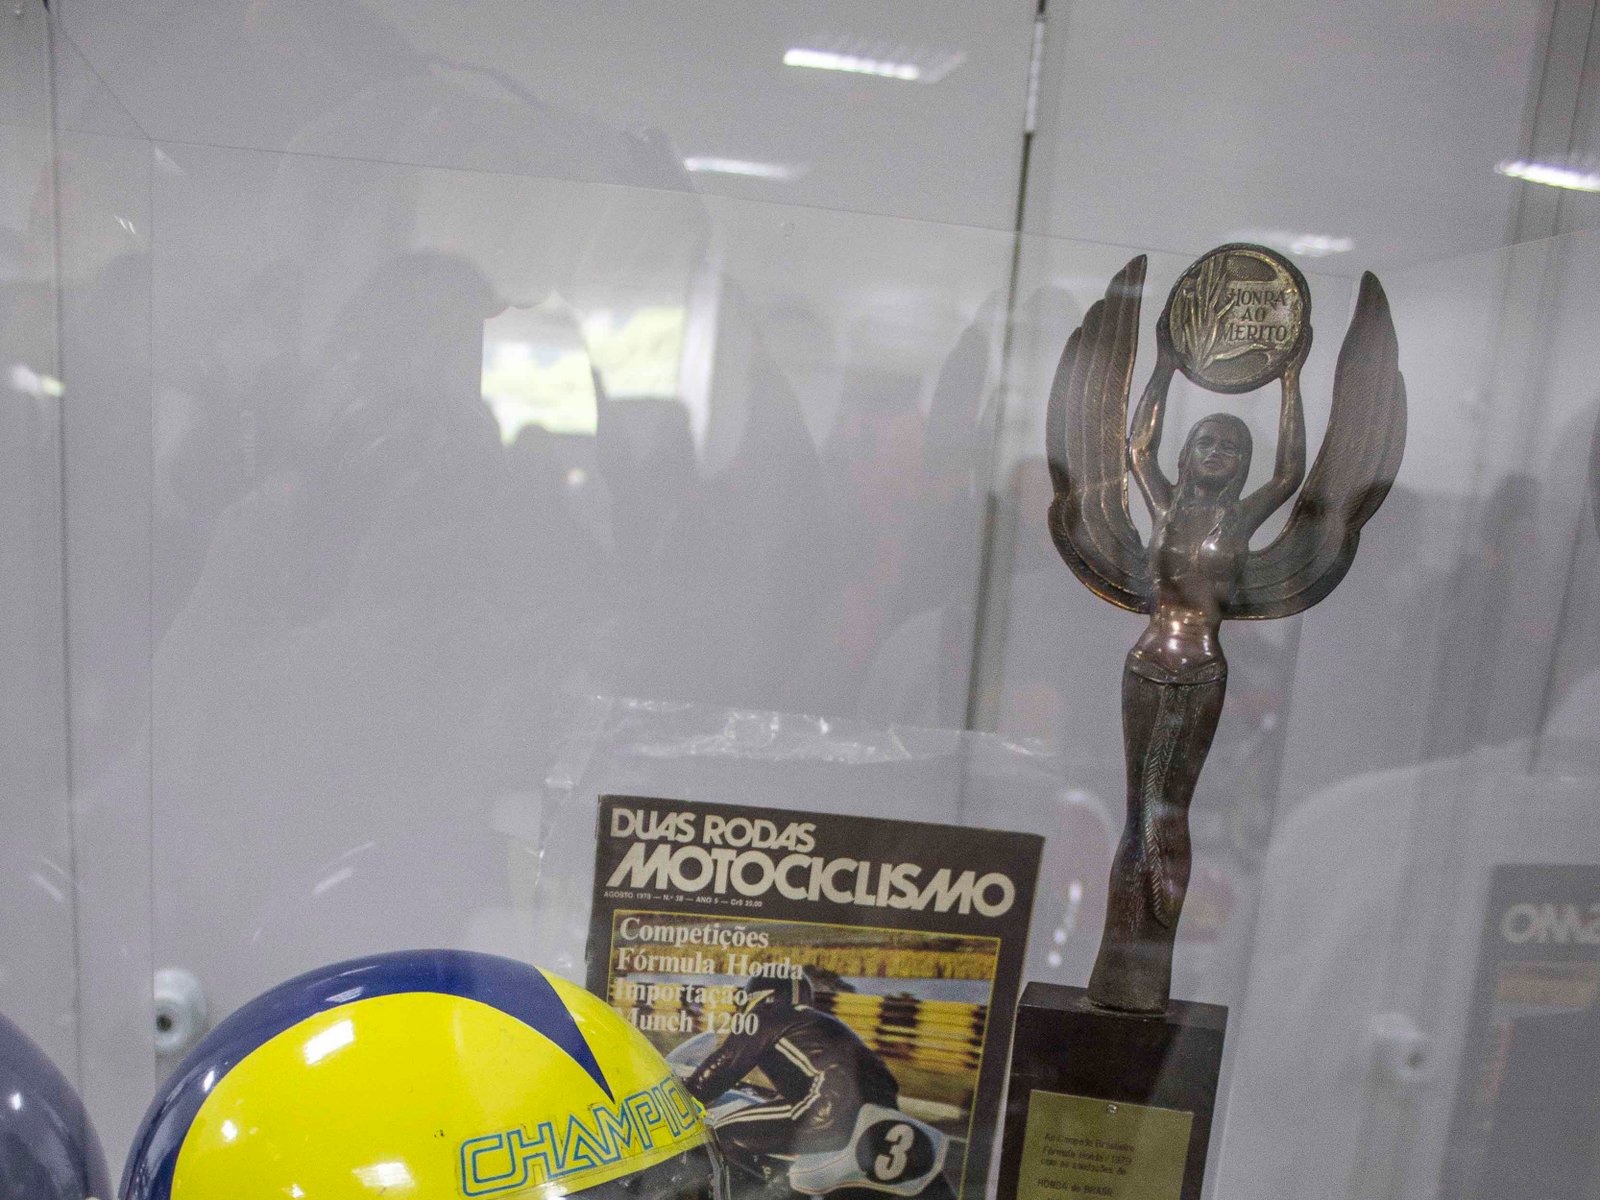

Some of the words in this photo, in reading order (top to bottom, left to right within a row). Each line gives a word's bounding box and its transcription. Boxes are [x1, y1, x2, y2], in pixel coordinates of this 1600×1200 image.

[1224, 288, 1287, 310] HONRA
[1241, 307, 1266, 322] AO
[610, 806, 695, 844] DUAS
[703, 814, 817, 854] RODAS
[603, 891, 633, 899] AGOSTO
[605, 841, 1016, 919] MOTOCICLISMO
[619, 916, 769, 950] Competições
[616, 946, 716, 975] Fórmula
[727, 953, 803, 980] Honda
[613, 976, 748, 1008] Importação
[705, 1012, 759, 1036] 1200
[460, 1074, 705, 1197] CHAMPIO
[874, 1124, 915, 1181] 3
